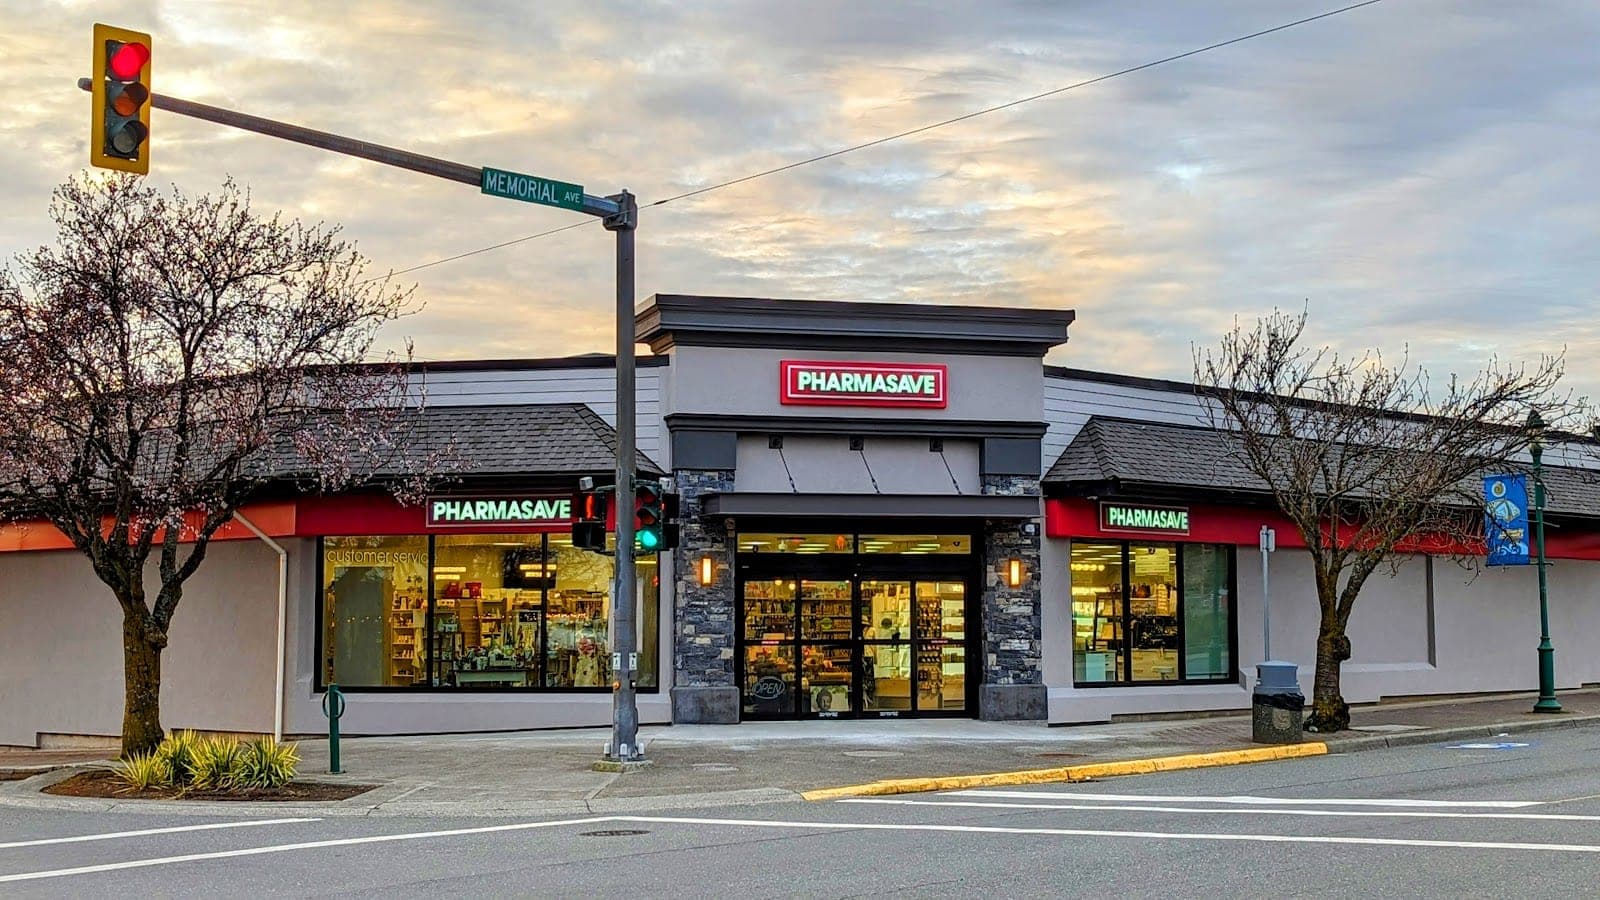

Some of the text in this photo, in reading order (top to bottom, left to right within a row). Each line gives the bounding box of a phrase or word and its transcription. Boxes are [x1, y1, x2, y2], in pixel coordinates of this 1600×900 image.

[485, 171, 581, 203] MEMORIAL AVE
[798, 371, 935, 394] PHARMASAVE
[433, 500, 571, 520] PHARMASAVE
[1109, 507, 1188, 530] PHARMASAVE
[327, 549, 428, 563] customer servic
[757, 682, 781, 694] OPEN
